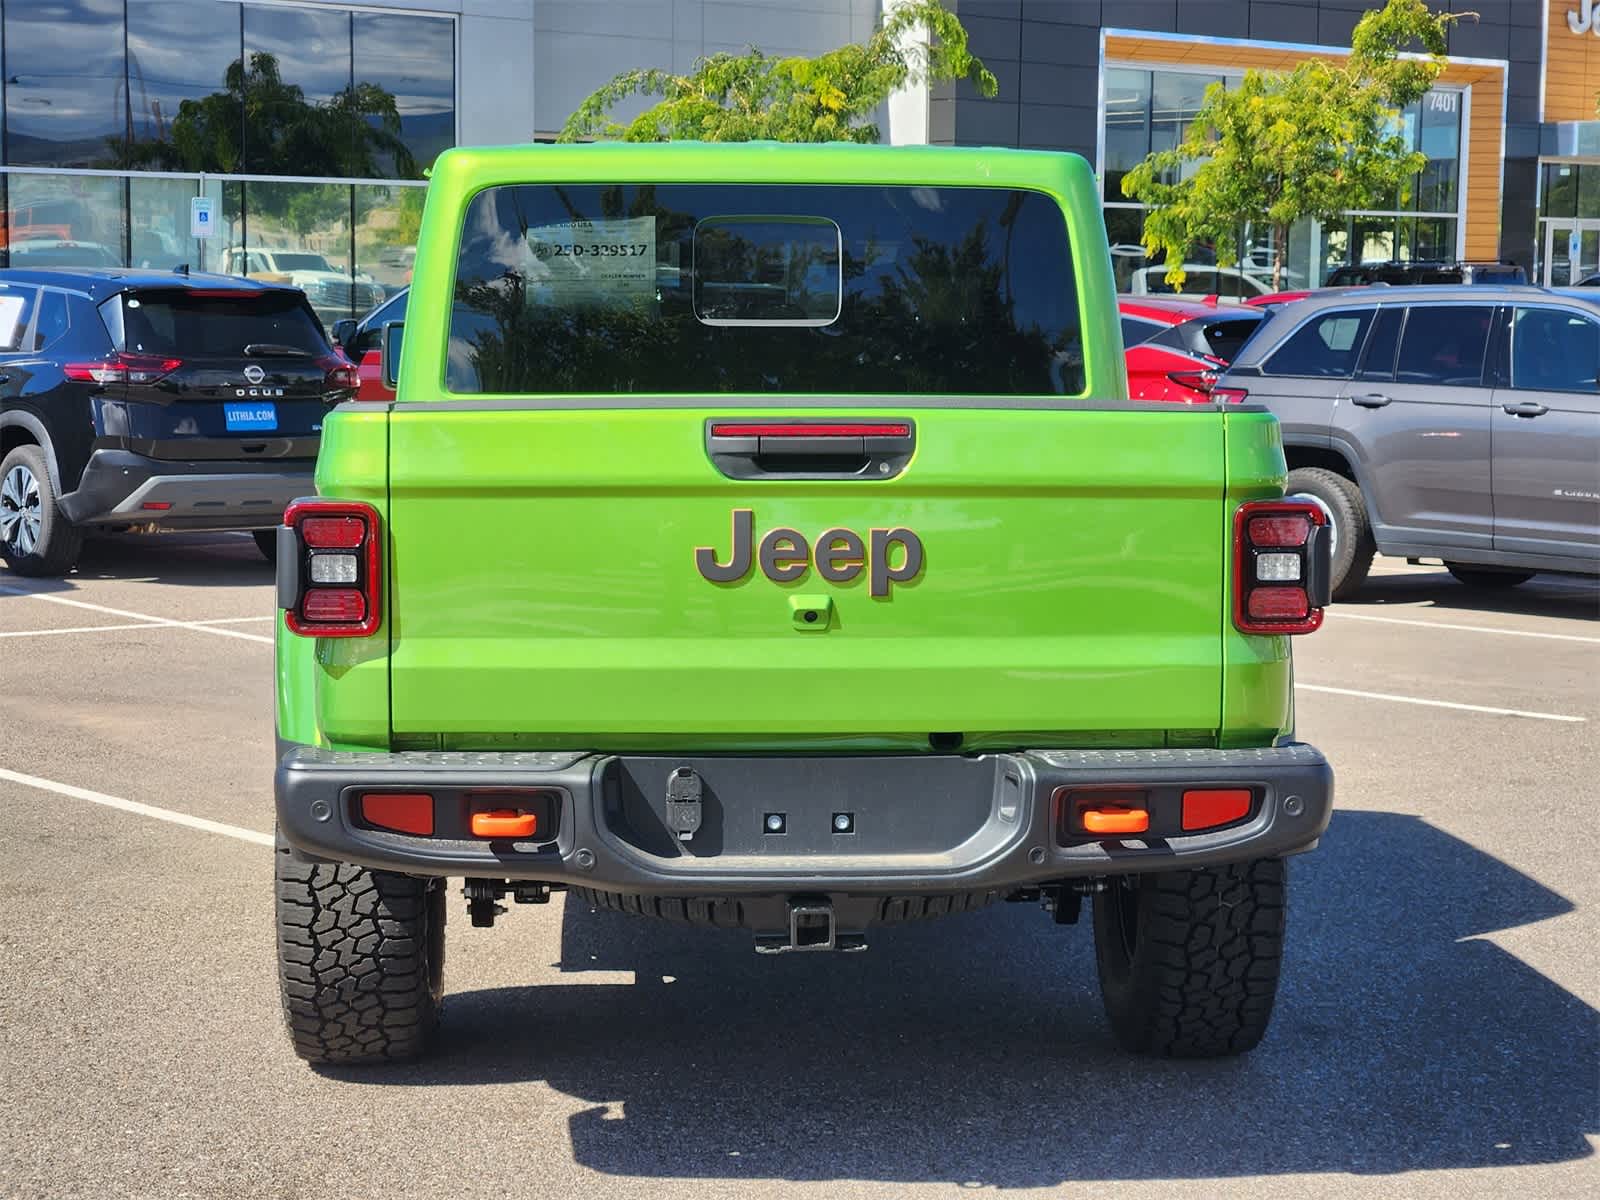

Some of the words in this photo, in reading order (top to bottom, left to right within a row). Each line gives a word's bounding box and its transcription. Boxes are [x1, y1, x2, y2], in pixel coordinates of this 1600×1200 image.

[1430, 93, 1457, 112] 7401
[227, 410, 275, 422] LITHIA.COM
[695, 508, 924, 597] Jeep
